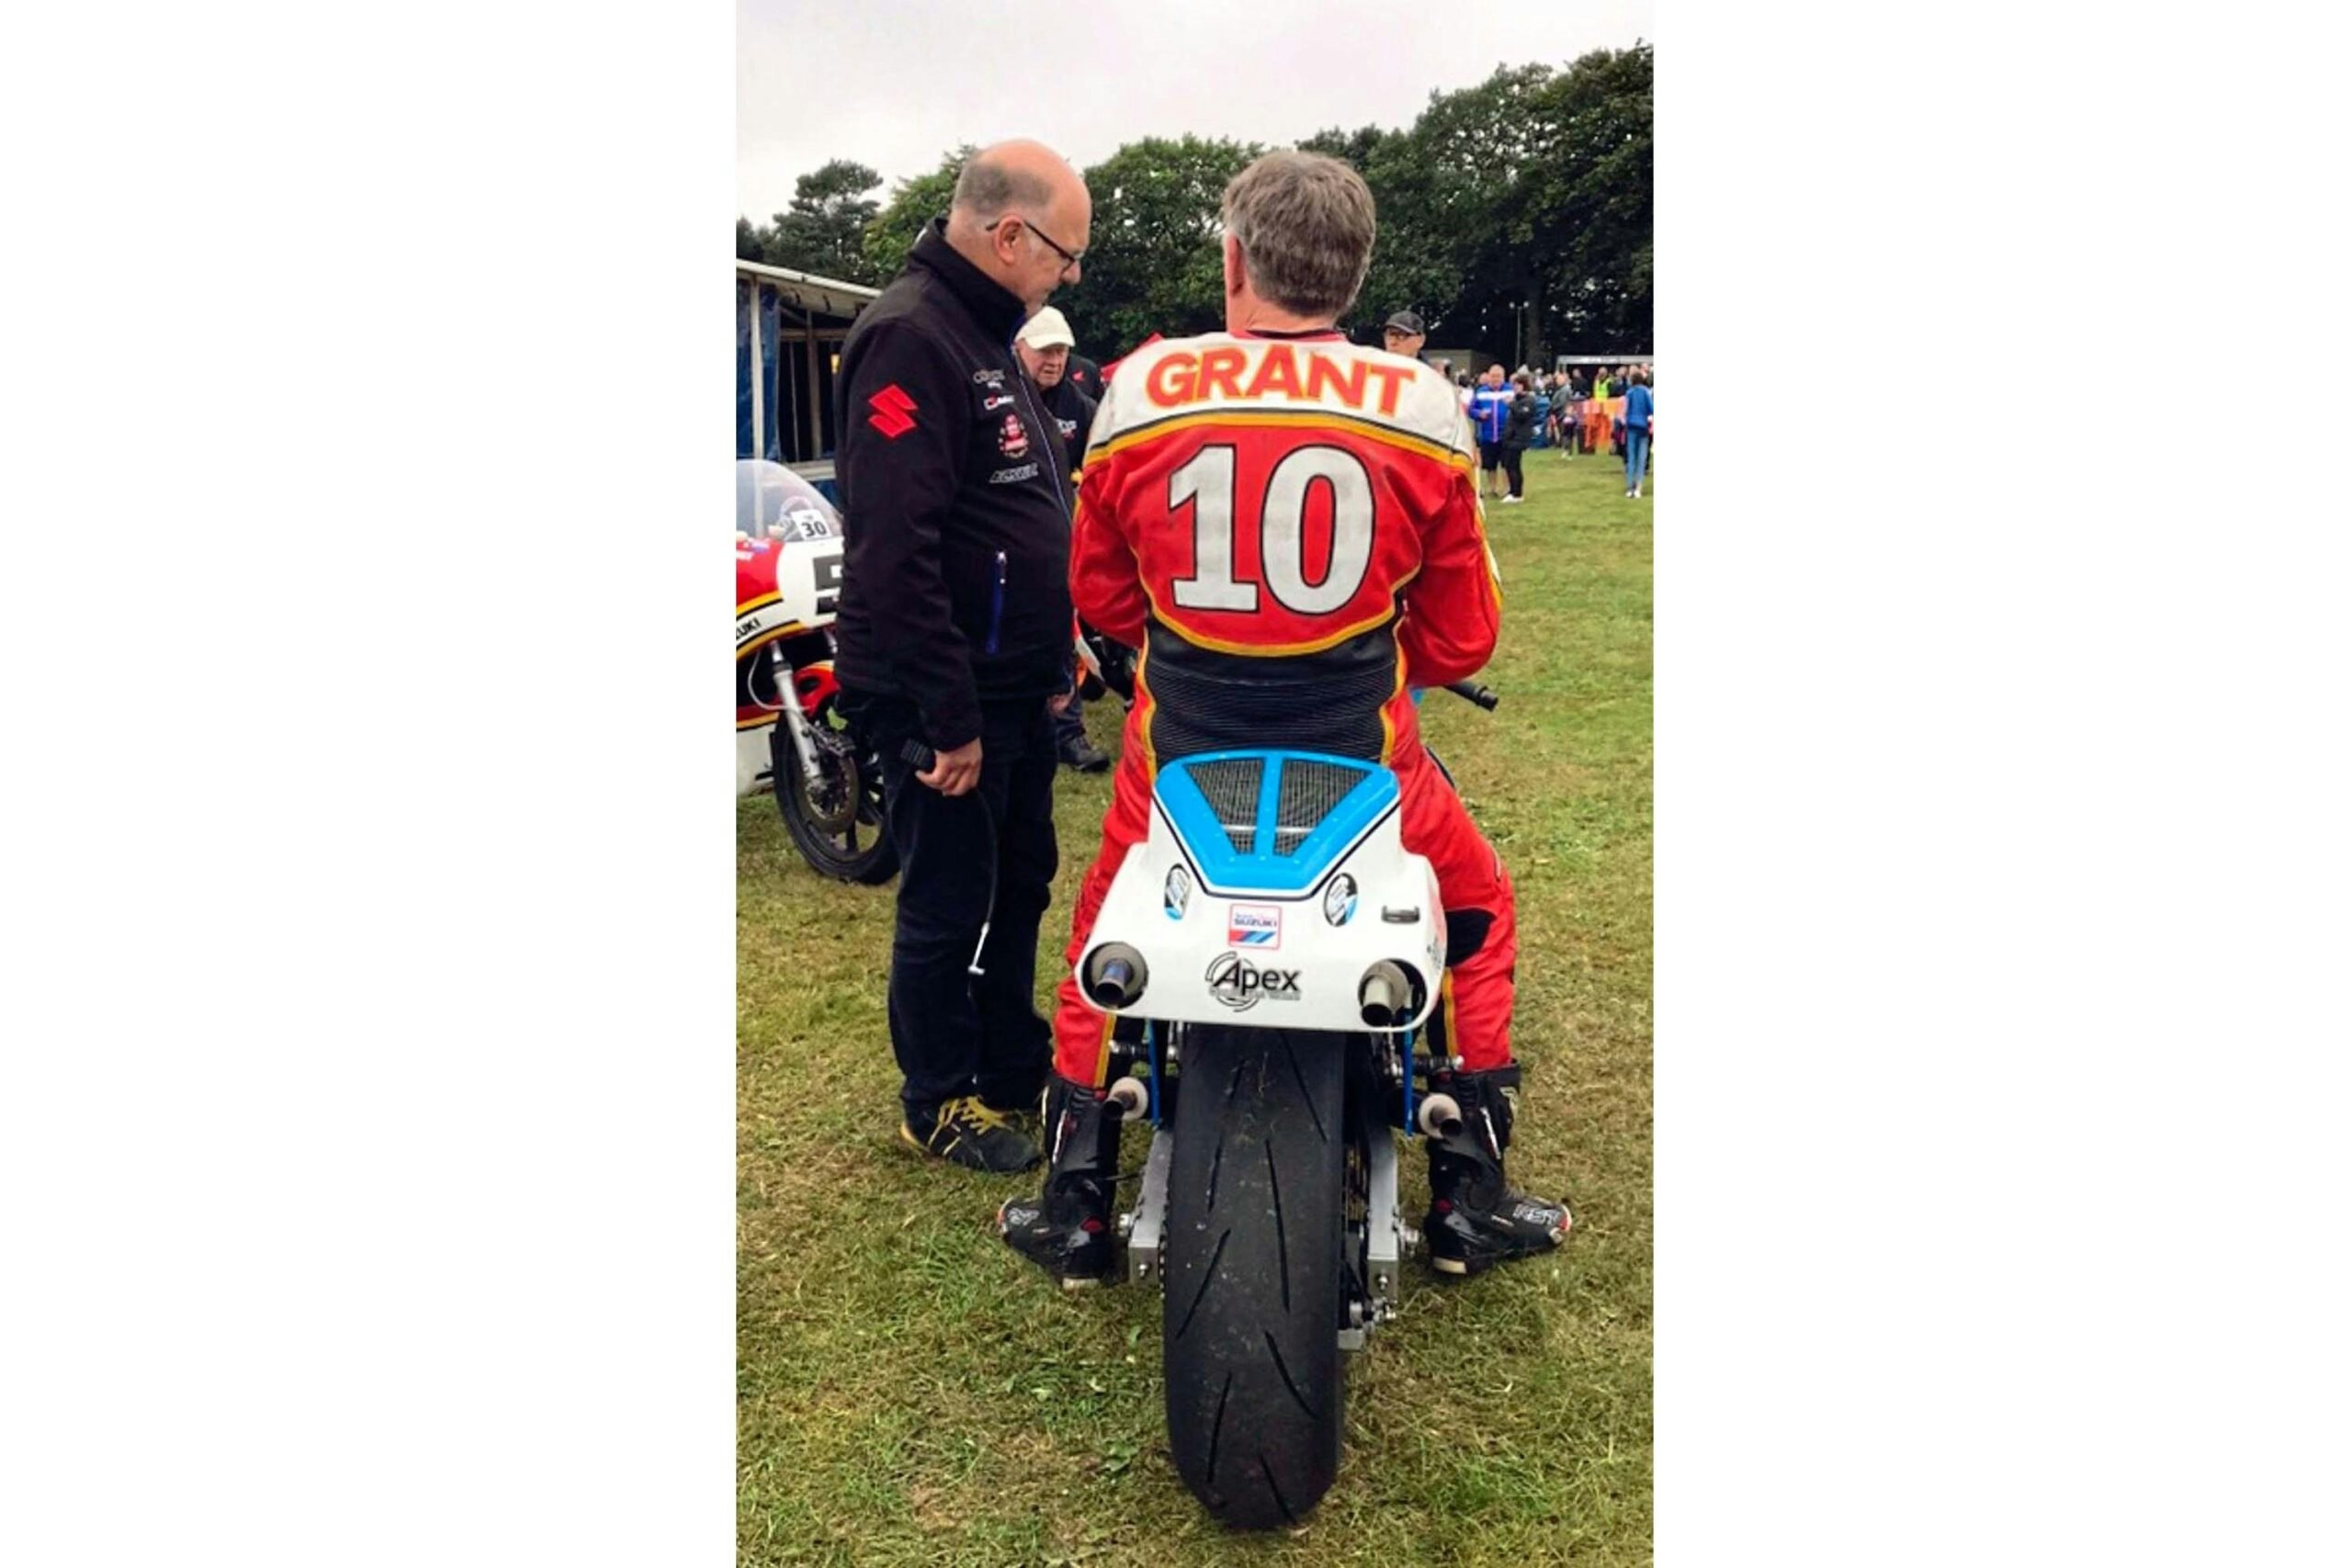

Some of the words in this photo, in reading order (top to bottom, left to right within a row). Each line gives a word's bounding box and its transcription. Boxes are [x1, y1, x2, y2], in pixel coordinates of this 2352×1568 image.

[1146, 343, 1416, 418] GRANT
[799, 520, 827, 537] 30
[1168, 443, 1376, 616] 10
[1234, 917, 1278, 928] SUZUKI
[1212, 958, 1302, 997] Apex
